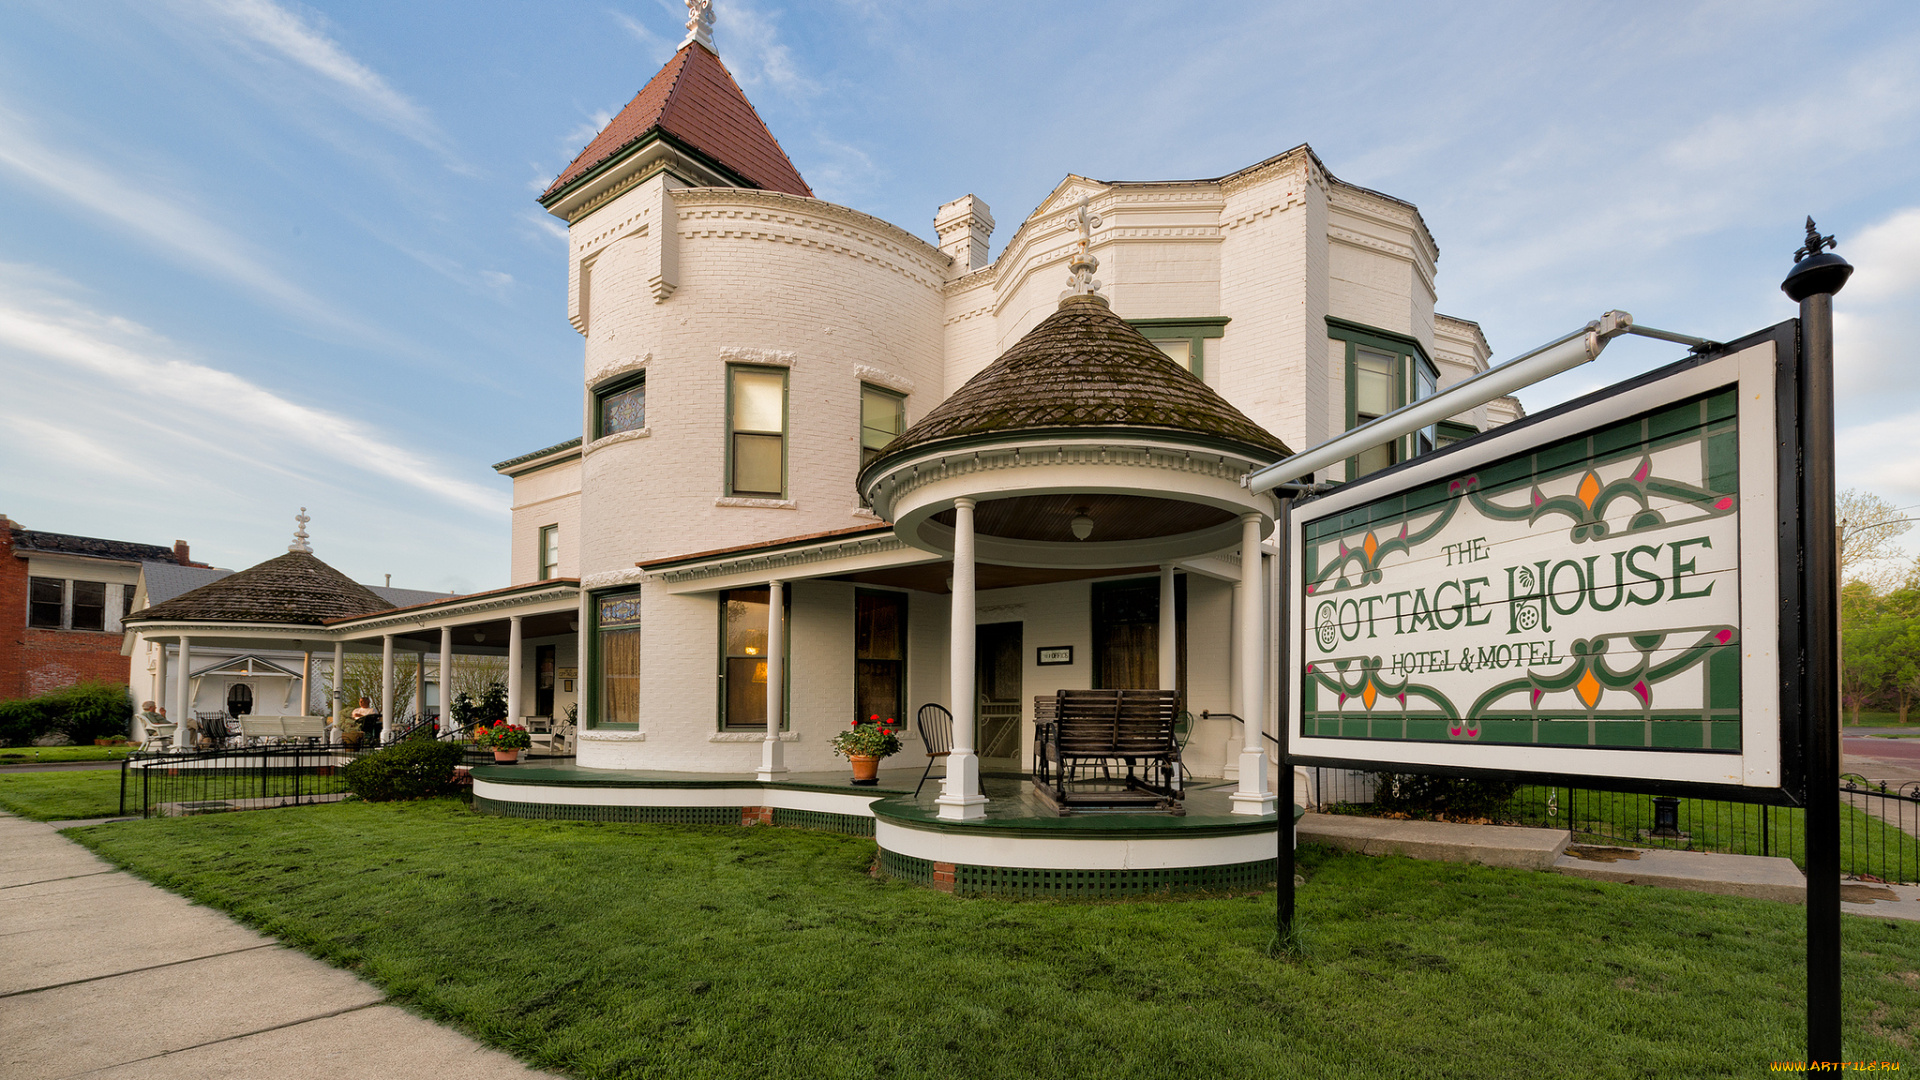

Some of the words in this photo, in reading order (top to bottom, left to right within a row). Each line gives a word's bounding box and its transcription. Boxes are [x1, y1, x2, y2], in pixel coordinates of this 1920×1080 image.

[1441, 537, 1490, 567] THE
[1315, 576, 1493, 653] COTTAGE
[1503, 536, 1716, 634] HOUSE
[1391, 650, 1456, 677] HOTEL
[1458, 647, 1475, 673] &
[1476, 640, 1565, 670] MOTEL
